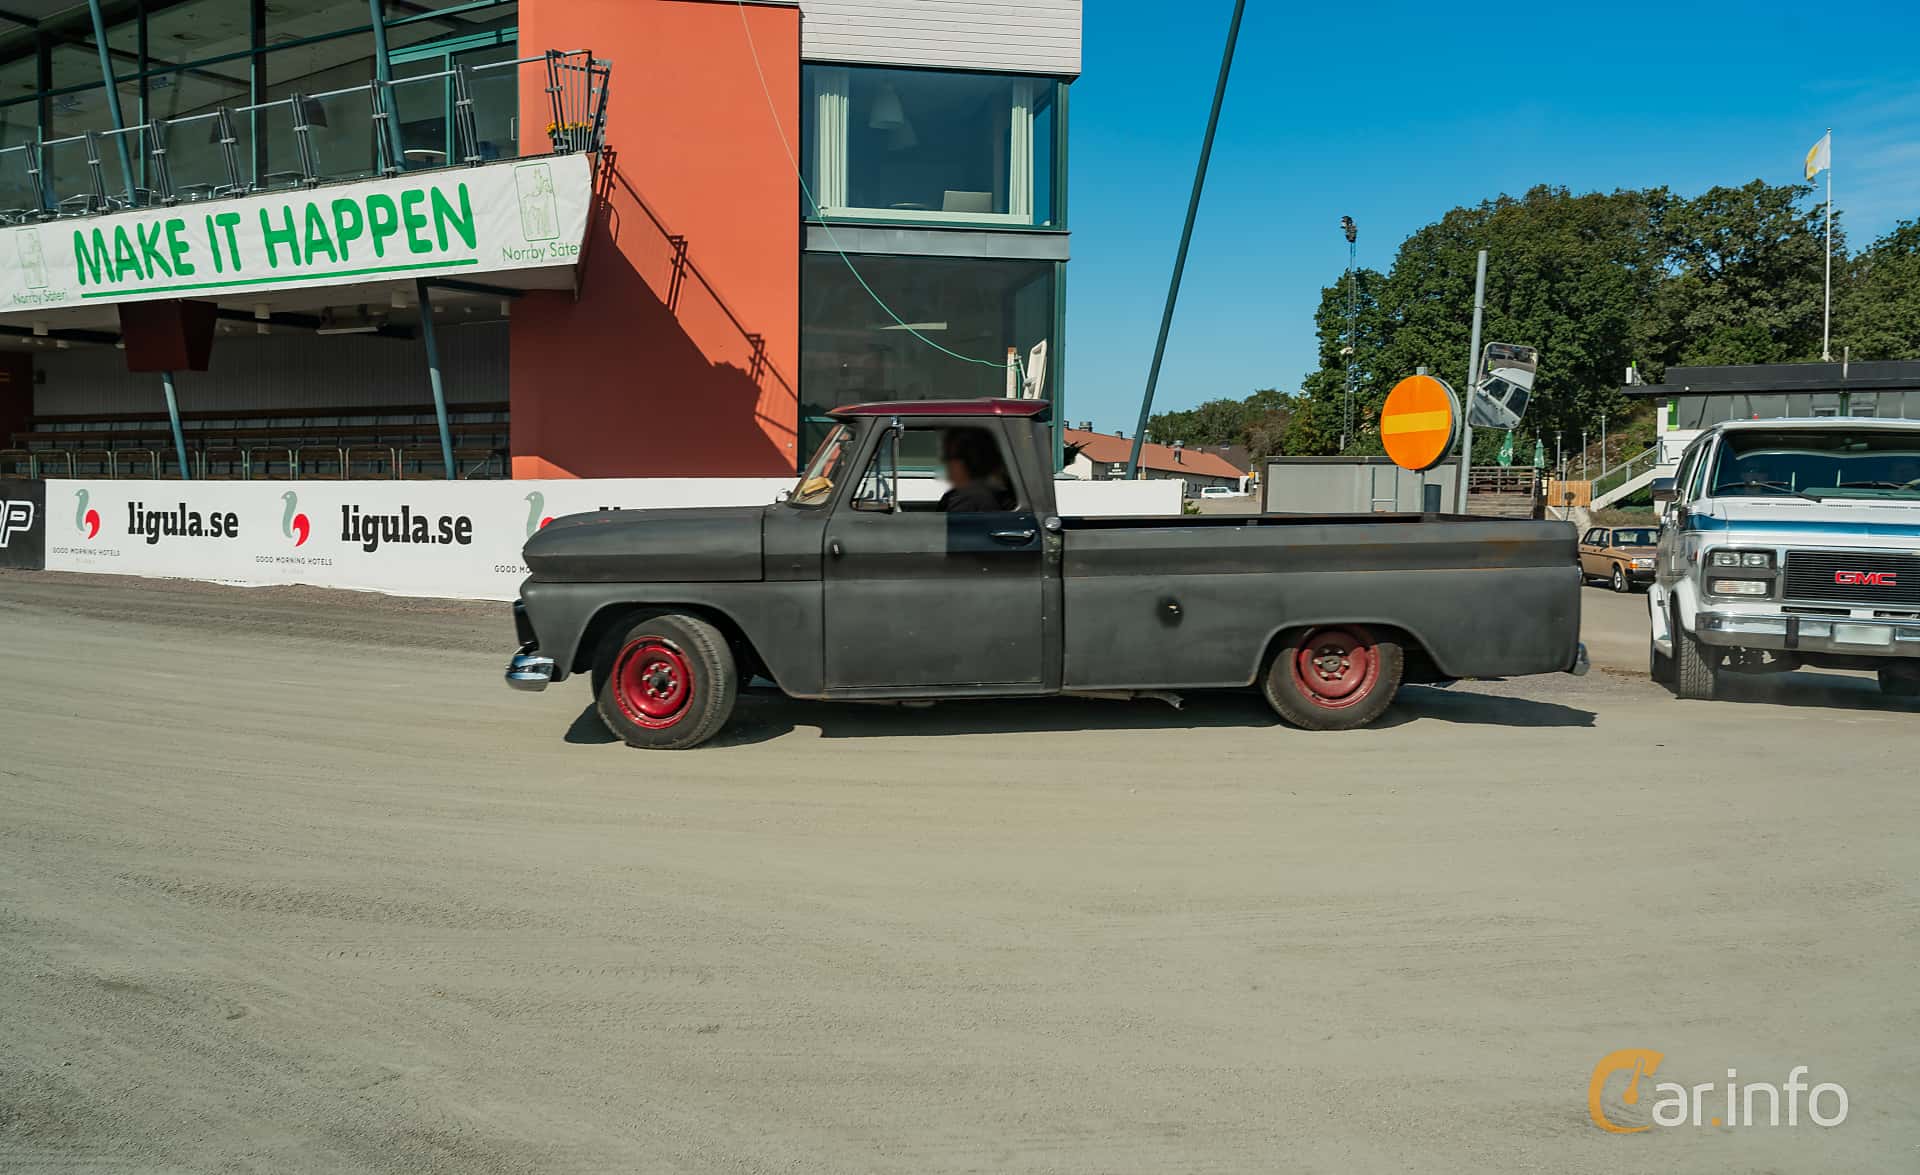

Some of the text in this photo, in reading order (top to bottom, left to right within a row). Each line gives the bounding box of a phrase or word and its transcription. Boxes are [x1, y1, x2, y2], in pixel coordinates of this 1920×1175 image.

[74, 182, 478, 286] MAKE IT HAPPEN
[502, 244, 546, 262] Norrby
[127, 501, 239, 545] ligula.se
[341, 504, 473, 553] ligula.se
[494, 565, 517, 573] GOOD
[1835, 571, 1897, 586] GMC
